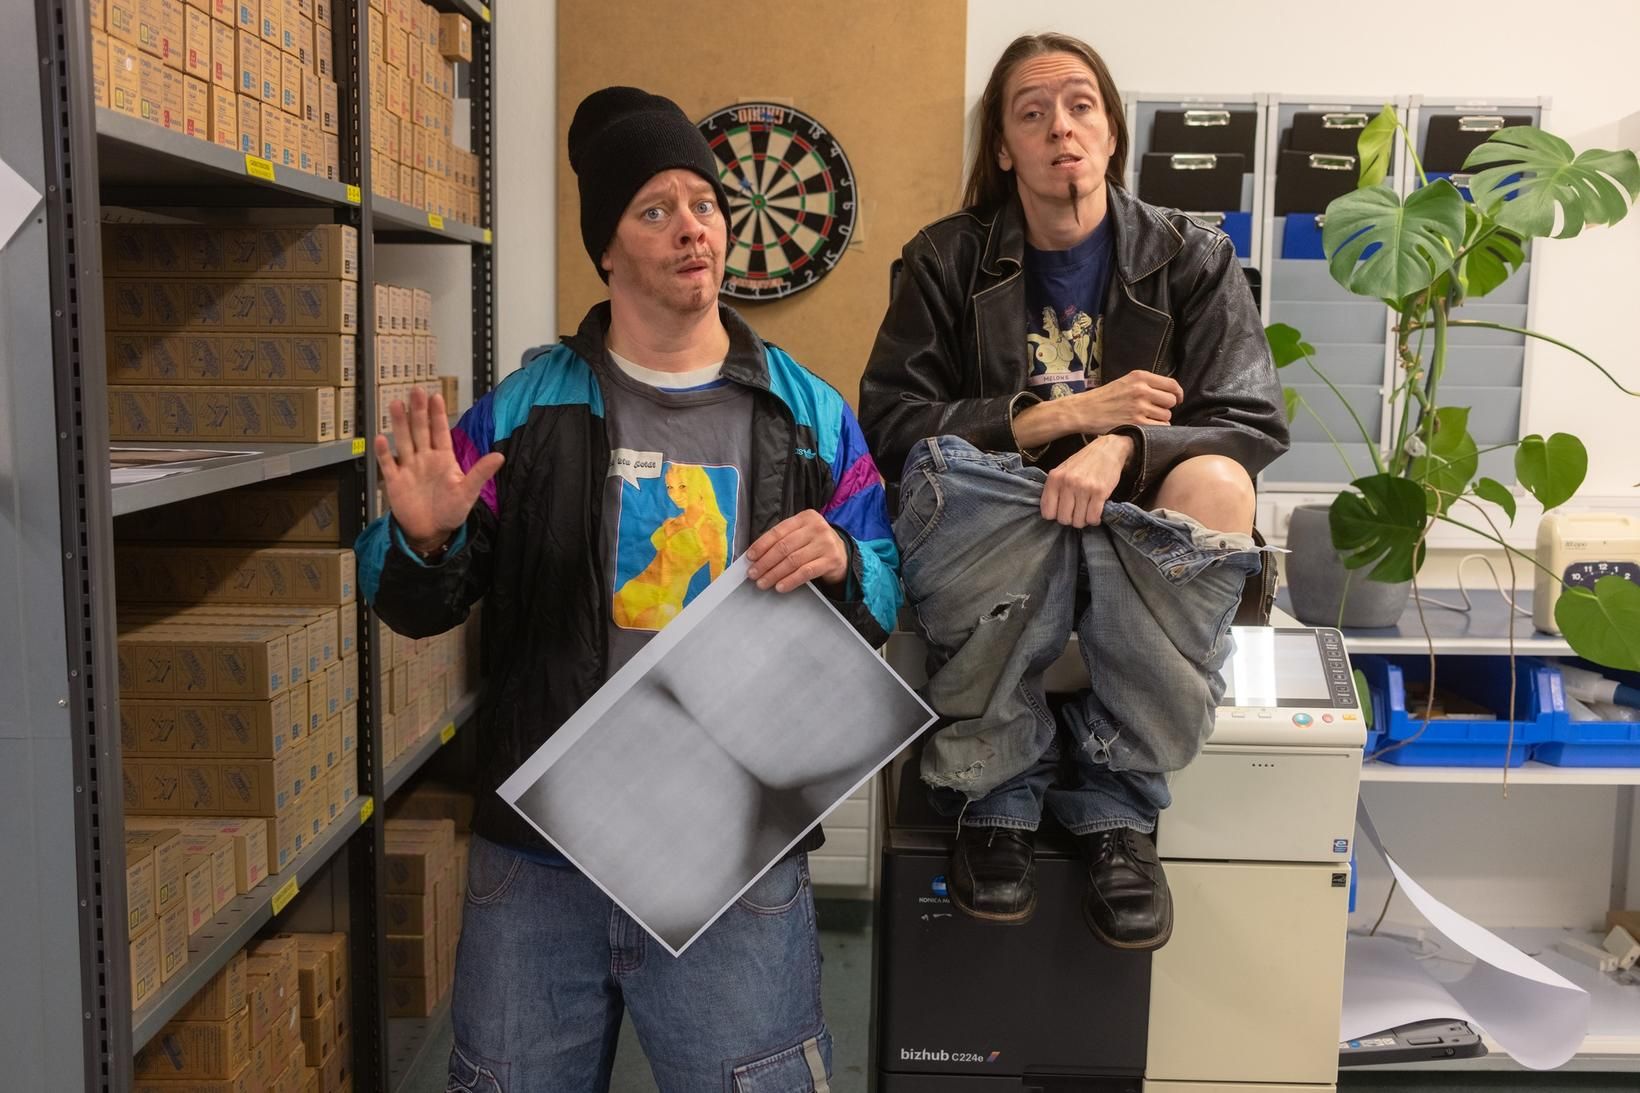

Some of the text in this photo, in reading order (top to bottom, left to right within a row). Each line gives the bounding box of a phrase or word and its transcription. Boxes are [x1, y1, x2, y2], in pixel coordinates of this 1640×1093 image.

[1571, 573, 1581, 581] 10
[1624, 572, 1631, 580] 2
[900, 1048, 984, 1063] bizhub C224e
